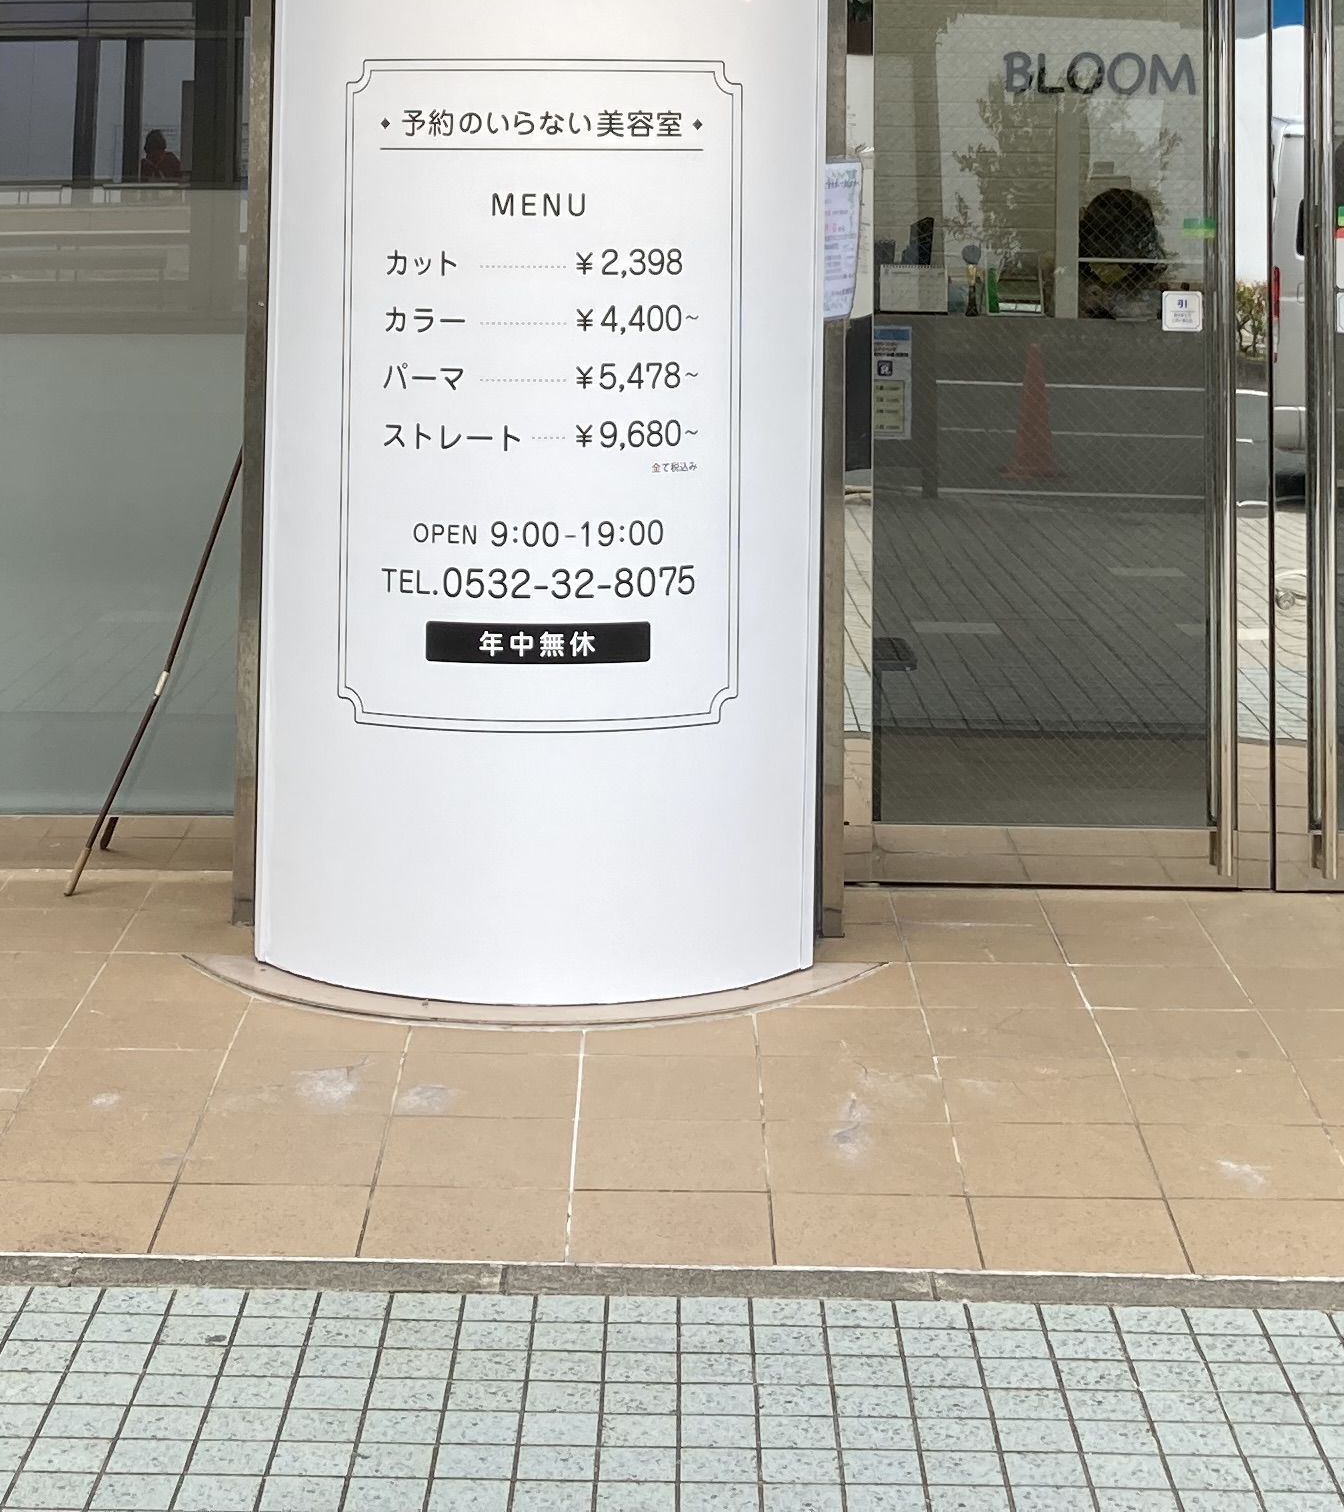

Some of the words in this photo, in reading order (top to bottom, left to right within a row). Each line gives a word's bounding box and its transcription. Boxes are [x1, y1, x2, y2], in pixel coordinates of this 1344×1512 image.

[1002, 49, 1197, 96] BLOOM
[400, 108, 684, 139] 予約のいらない美容室
[490, 191, 587, 218] MENU
[385, 248, 457, 278] カット
[575, 247, 684, 279] ¥2,398
[1176, 298, 1188, 309] 引
[384, 304, 467, 334] カラー
[382, 362, 465, 391] パーマ
[382, 422, 522, 452] ストレート
[412, 522, 478, 546] OPEN
[489, 518, 665, 549] 9:00-19:00
[478, 630, 596, 658] 年中無休
